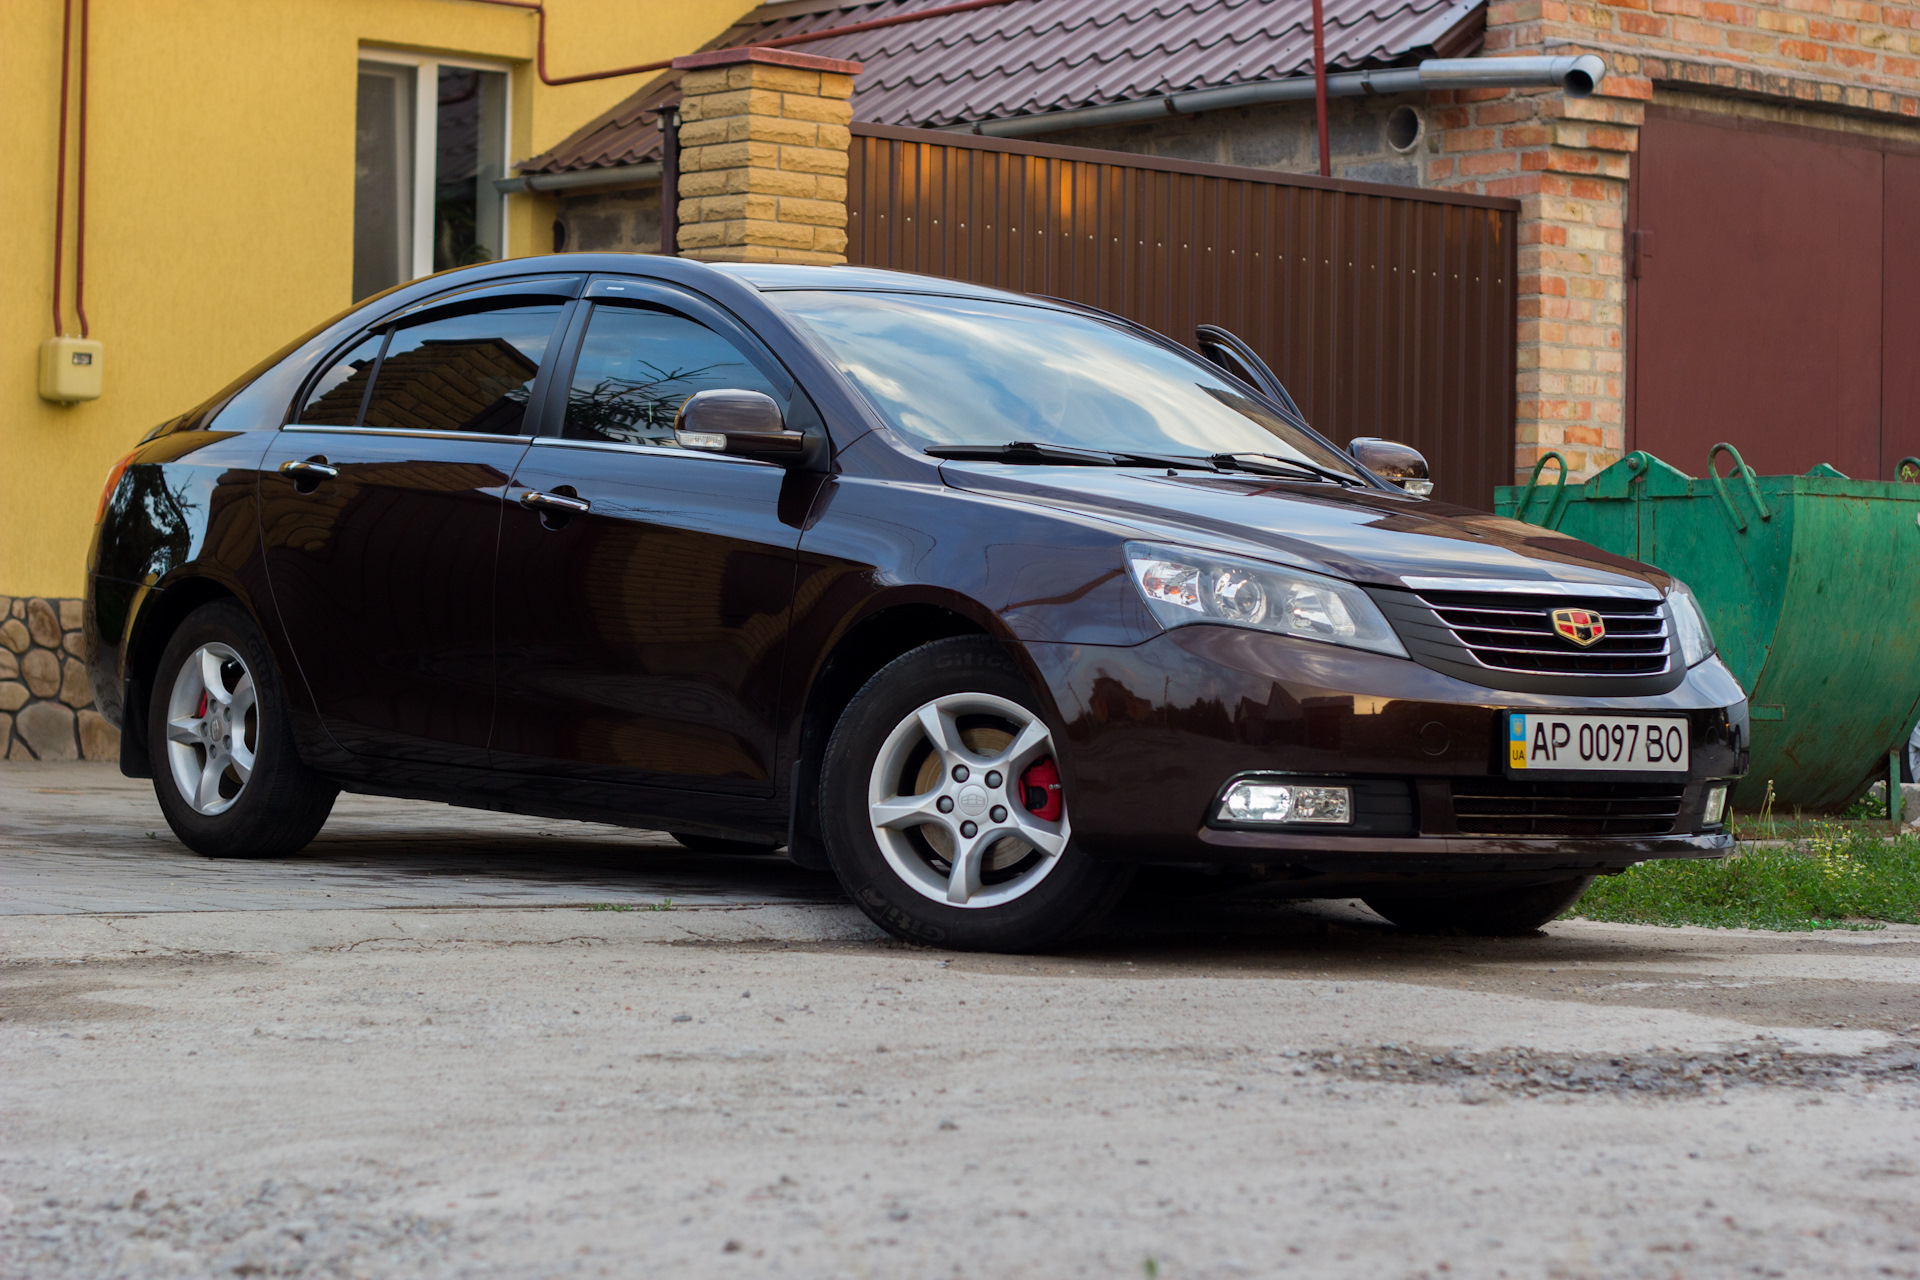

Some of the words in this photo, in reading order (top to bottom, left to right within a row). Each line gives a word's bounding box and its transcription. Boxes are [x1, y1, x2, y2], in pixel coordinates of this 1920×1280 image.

[1512, 750, 1526, 761] UA
[1531, 722, 1571, 761] AP
[1579, 723, 1639, 762] 0097
[1646, 725, 1683, 763] BO
